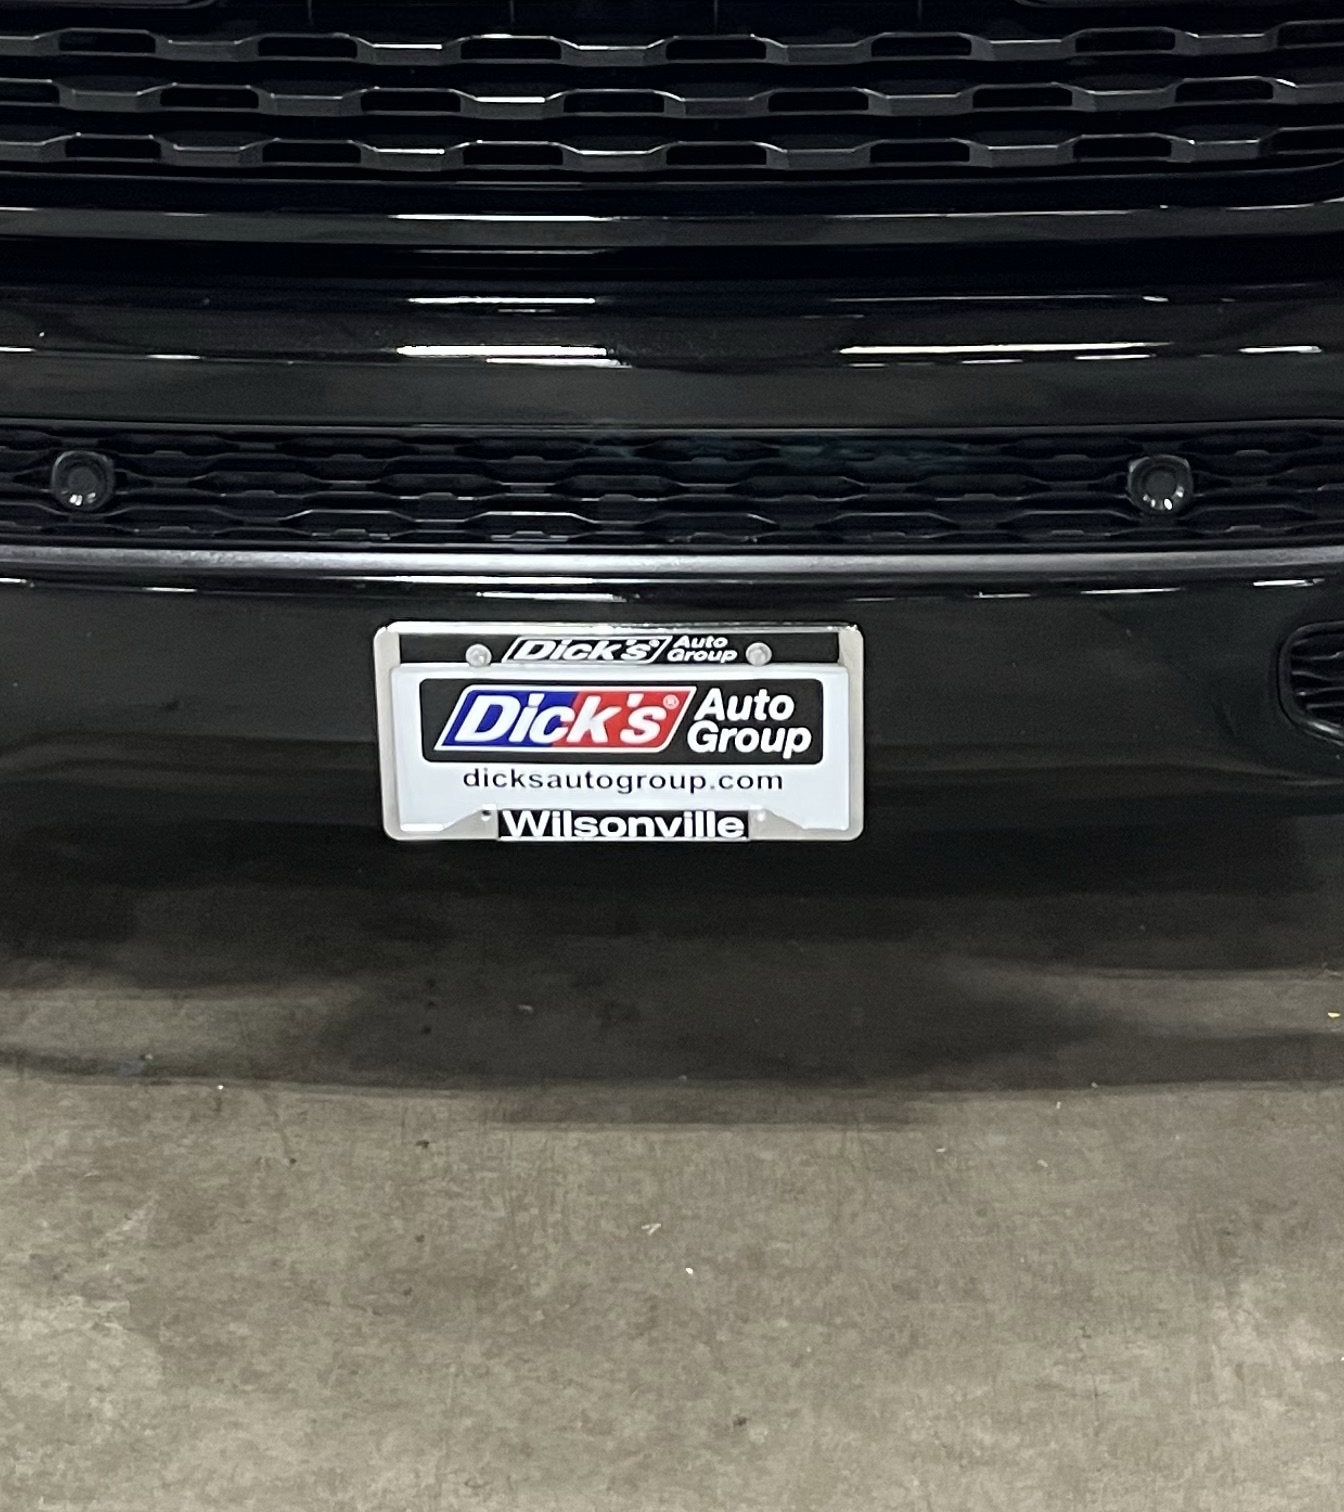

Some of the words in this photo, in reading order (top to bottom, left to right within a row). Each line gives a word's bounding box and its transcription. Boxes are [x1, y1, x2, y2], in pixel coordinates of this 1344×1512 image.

[666, 648, 738, 664] Group
[673, 635, 729, 649] Auto
[694, 687, 795, 721] Auto
[687, 718, 813, 760] Group
[463, 768, 784, 795] dicksautogroup.com
[501, 810, 746, 839] Wilsonville
